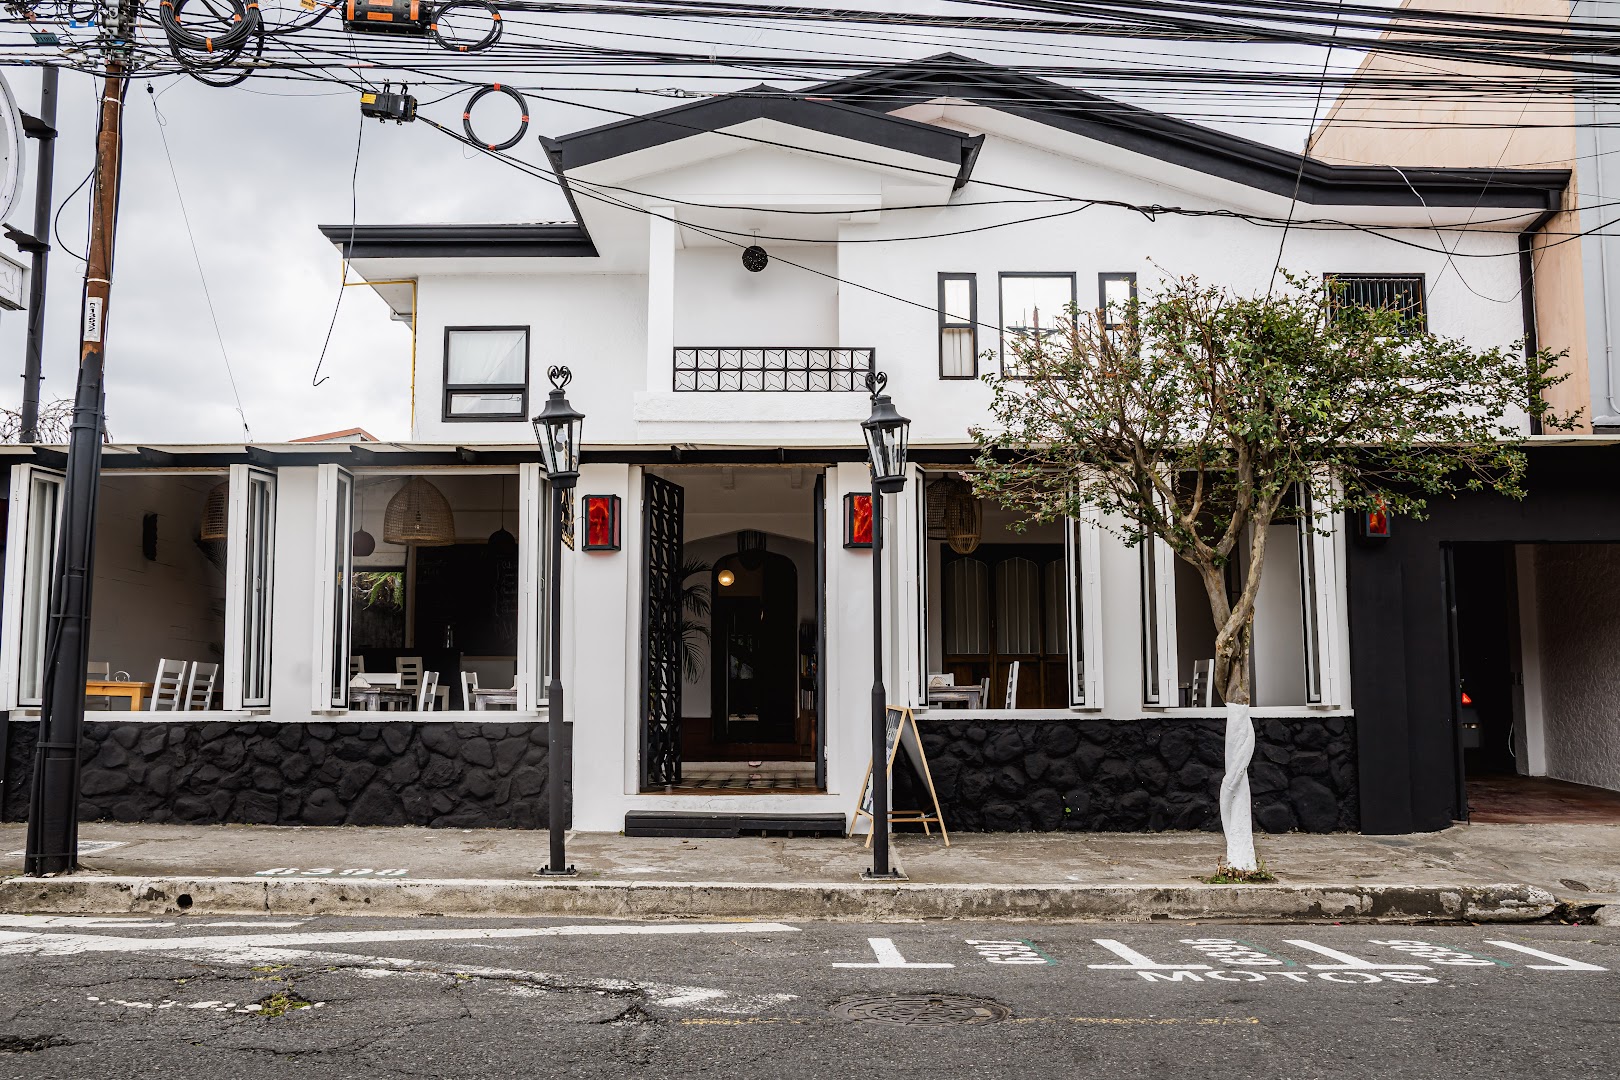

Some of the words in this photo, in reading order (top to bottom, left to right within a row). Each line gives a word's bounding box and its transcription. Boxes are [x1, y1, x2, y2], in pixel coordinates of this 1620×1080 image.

[964, 940, 1048, 965] 6397
[1179, 938, 1283, 966] 6396
[1368, 939, 1496, 966] 6395
[1137, 970, 1439, 984] MOTOS
